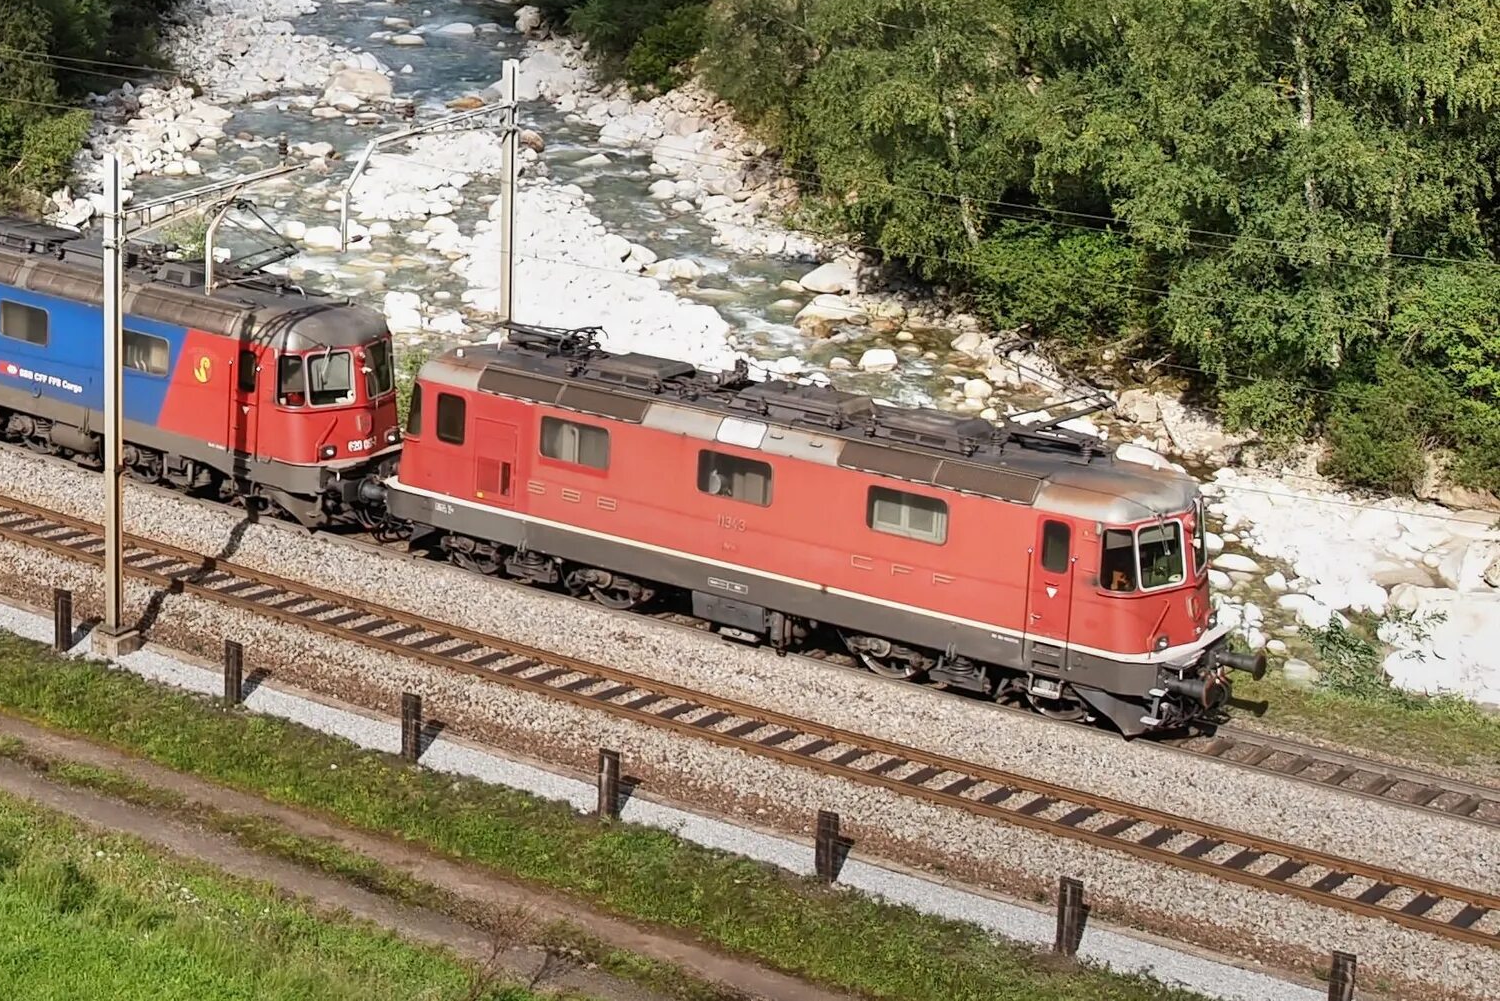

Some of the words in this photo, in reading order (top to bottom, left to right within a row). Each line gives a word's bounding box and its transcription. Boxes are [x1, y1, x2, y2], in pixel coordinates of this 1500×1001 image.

[62, 381, 83, 394] Cargo
[527, 480, 617, 511] SBB
[851, 554, 956, 585] CFF
